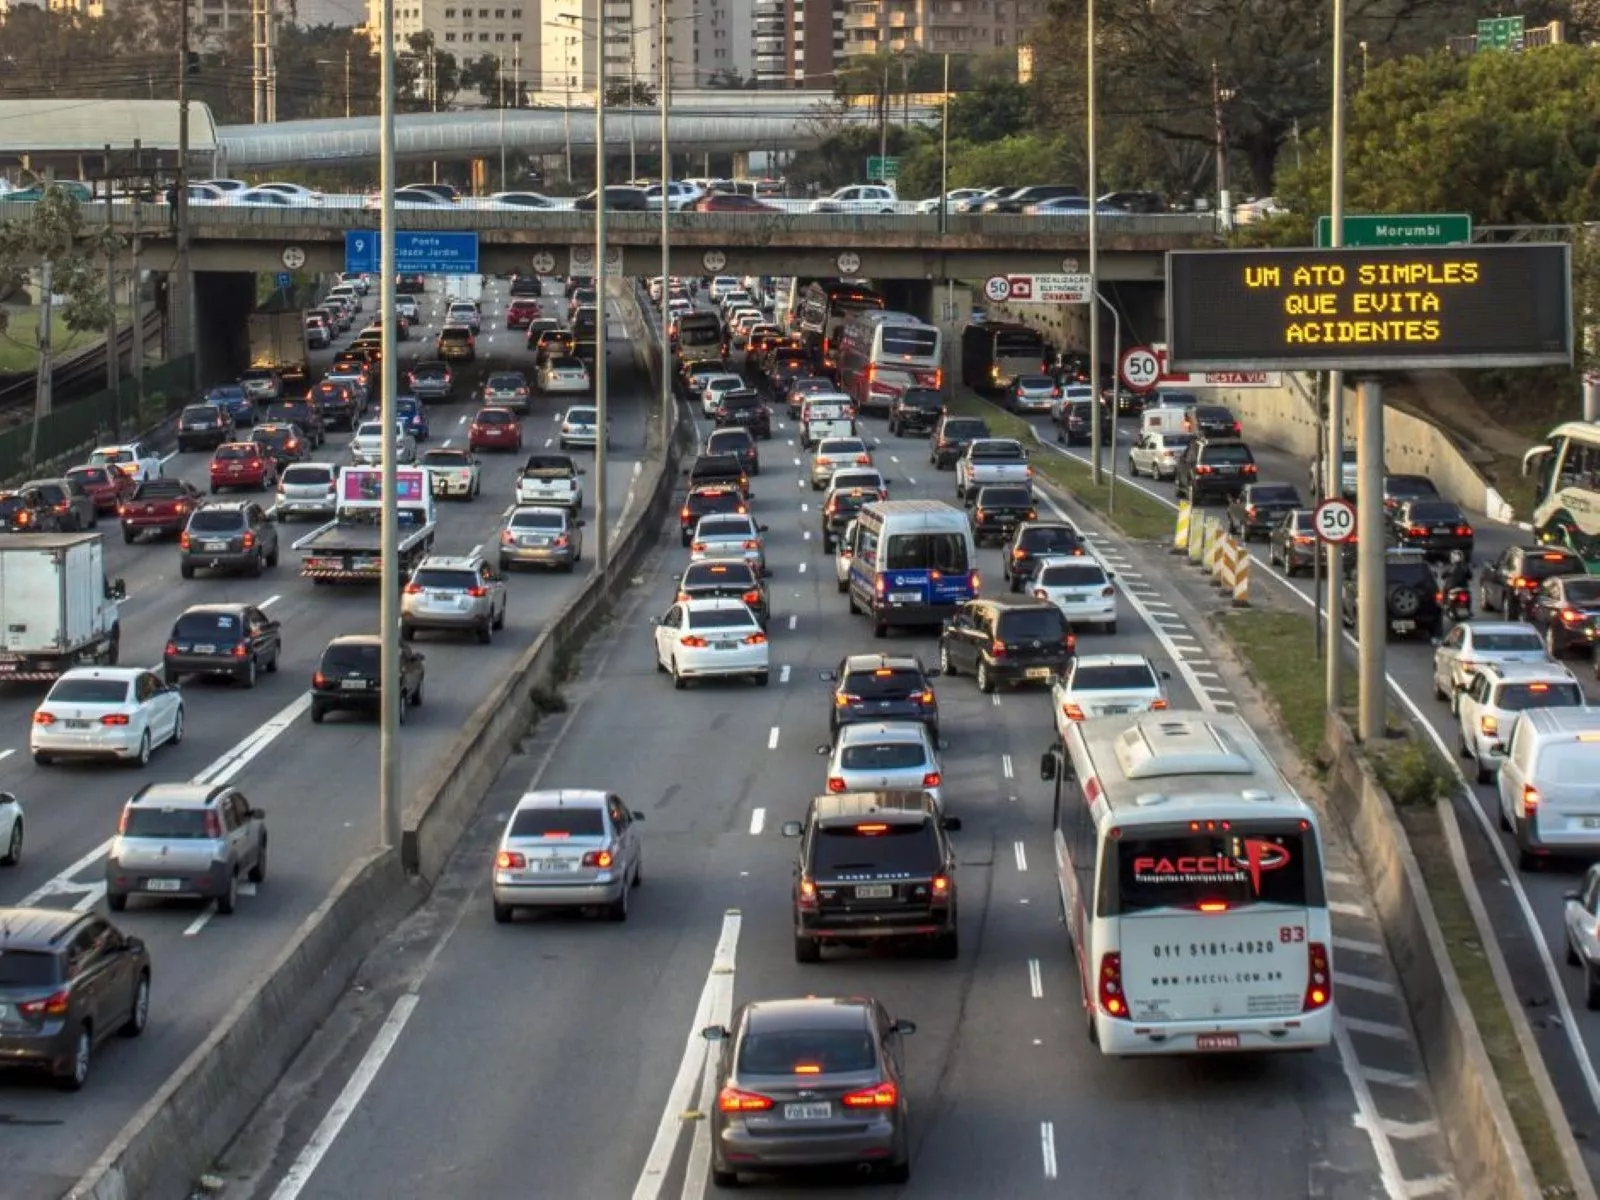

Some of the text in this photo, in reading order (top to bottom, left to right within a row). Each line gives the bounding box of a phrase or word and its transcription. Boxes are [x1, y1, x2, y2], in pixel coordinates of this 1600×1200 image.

[1376, 225, 1440, 236] Morumbi
[355, 239, 365, 252] 9
[1245, 263, 1478, 287] UM ATO SIMPLES
[990, 281, 1007, 293] 50
[1286, 292, 1440, 314] QUE EVITA
[1286, 320, 1440, 342] ACIDENTES
[1130, 358, 1155, 375] 50
[1206, 373, 1267, 383] NESTA VIA
[1323, 510, 1350, 528] 50
[1135, 853, 1236, 872] FACCIL
[1280, 926, 1304, 943] 83
[1154, 944, 1180, 957] 011
